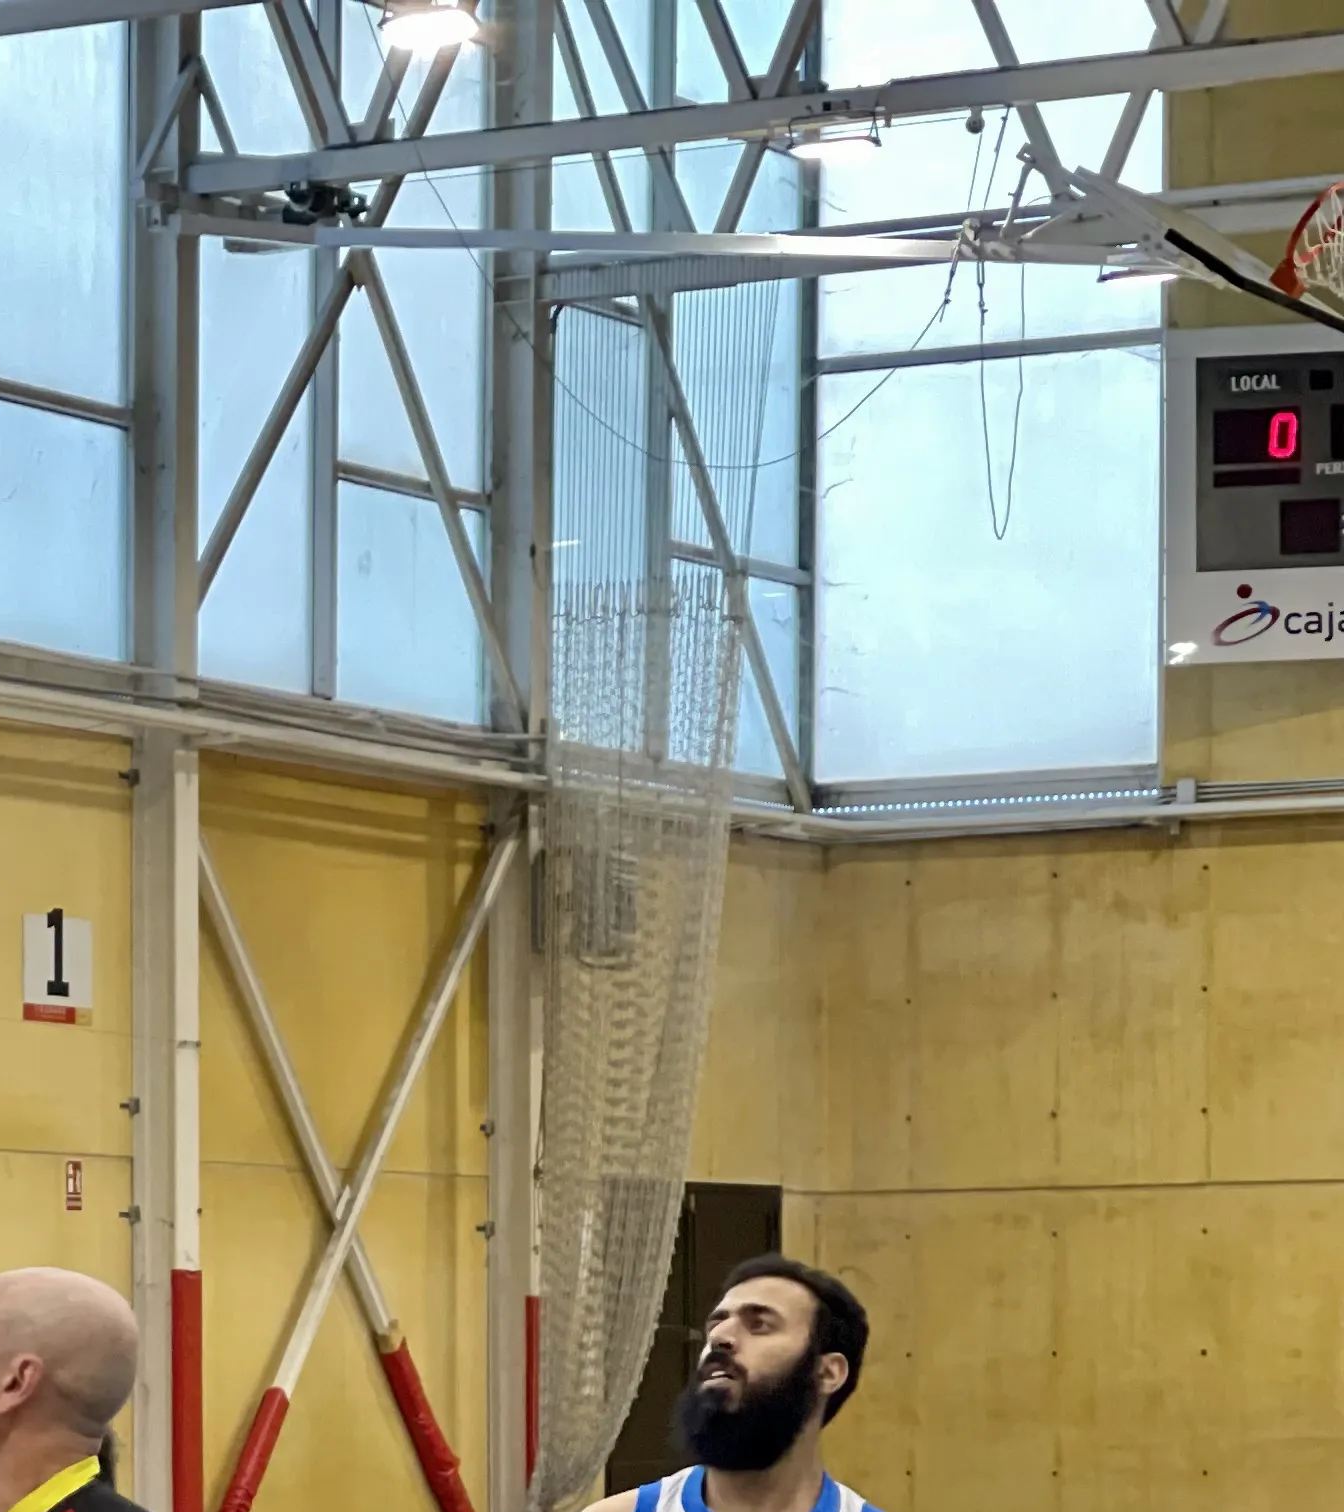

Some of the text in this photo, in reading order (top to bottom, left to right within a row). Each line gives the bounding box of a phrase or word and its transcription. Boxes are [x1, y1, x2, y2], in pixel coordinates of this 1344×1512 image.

[1231, 374, 1280, 392] LOCAL
[1268, 411, 1298, 459] 0
[46, 907, 70, 998] 1
